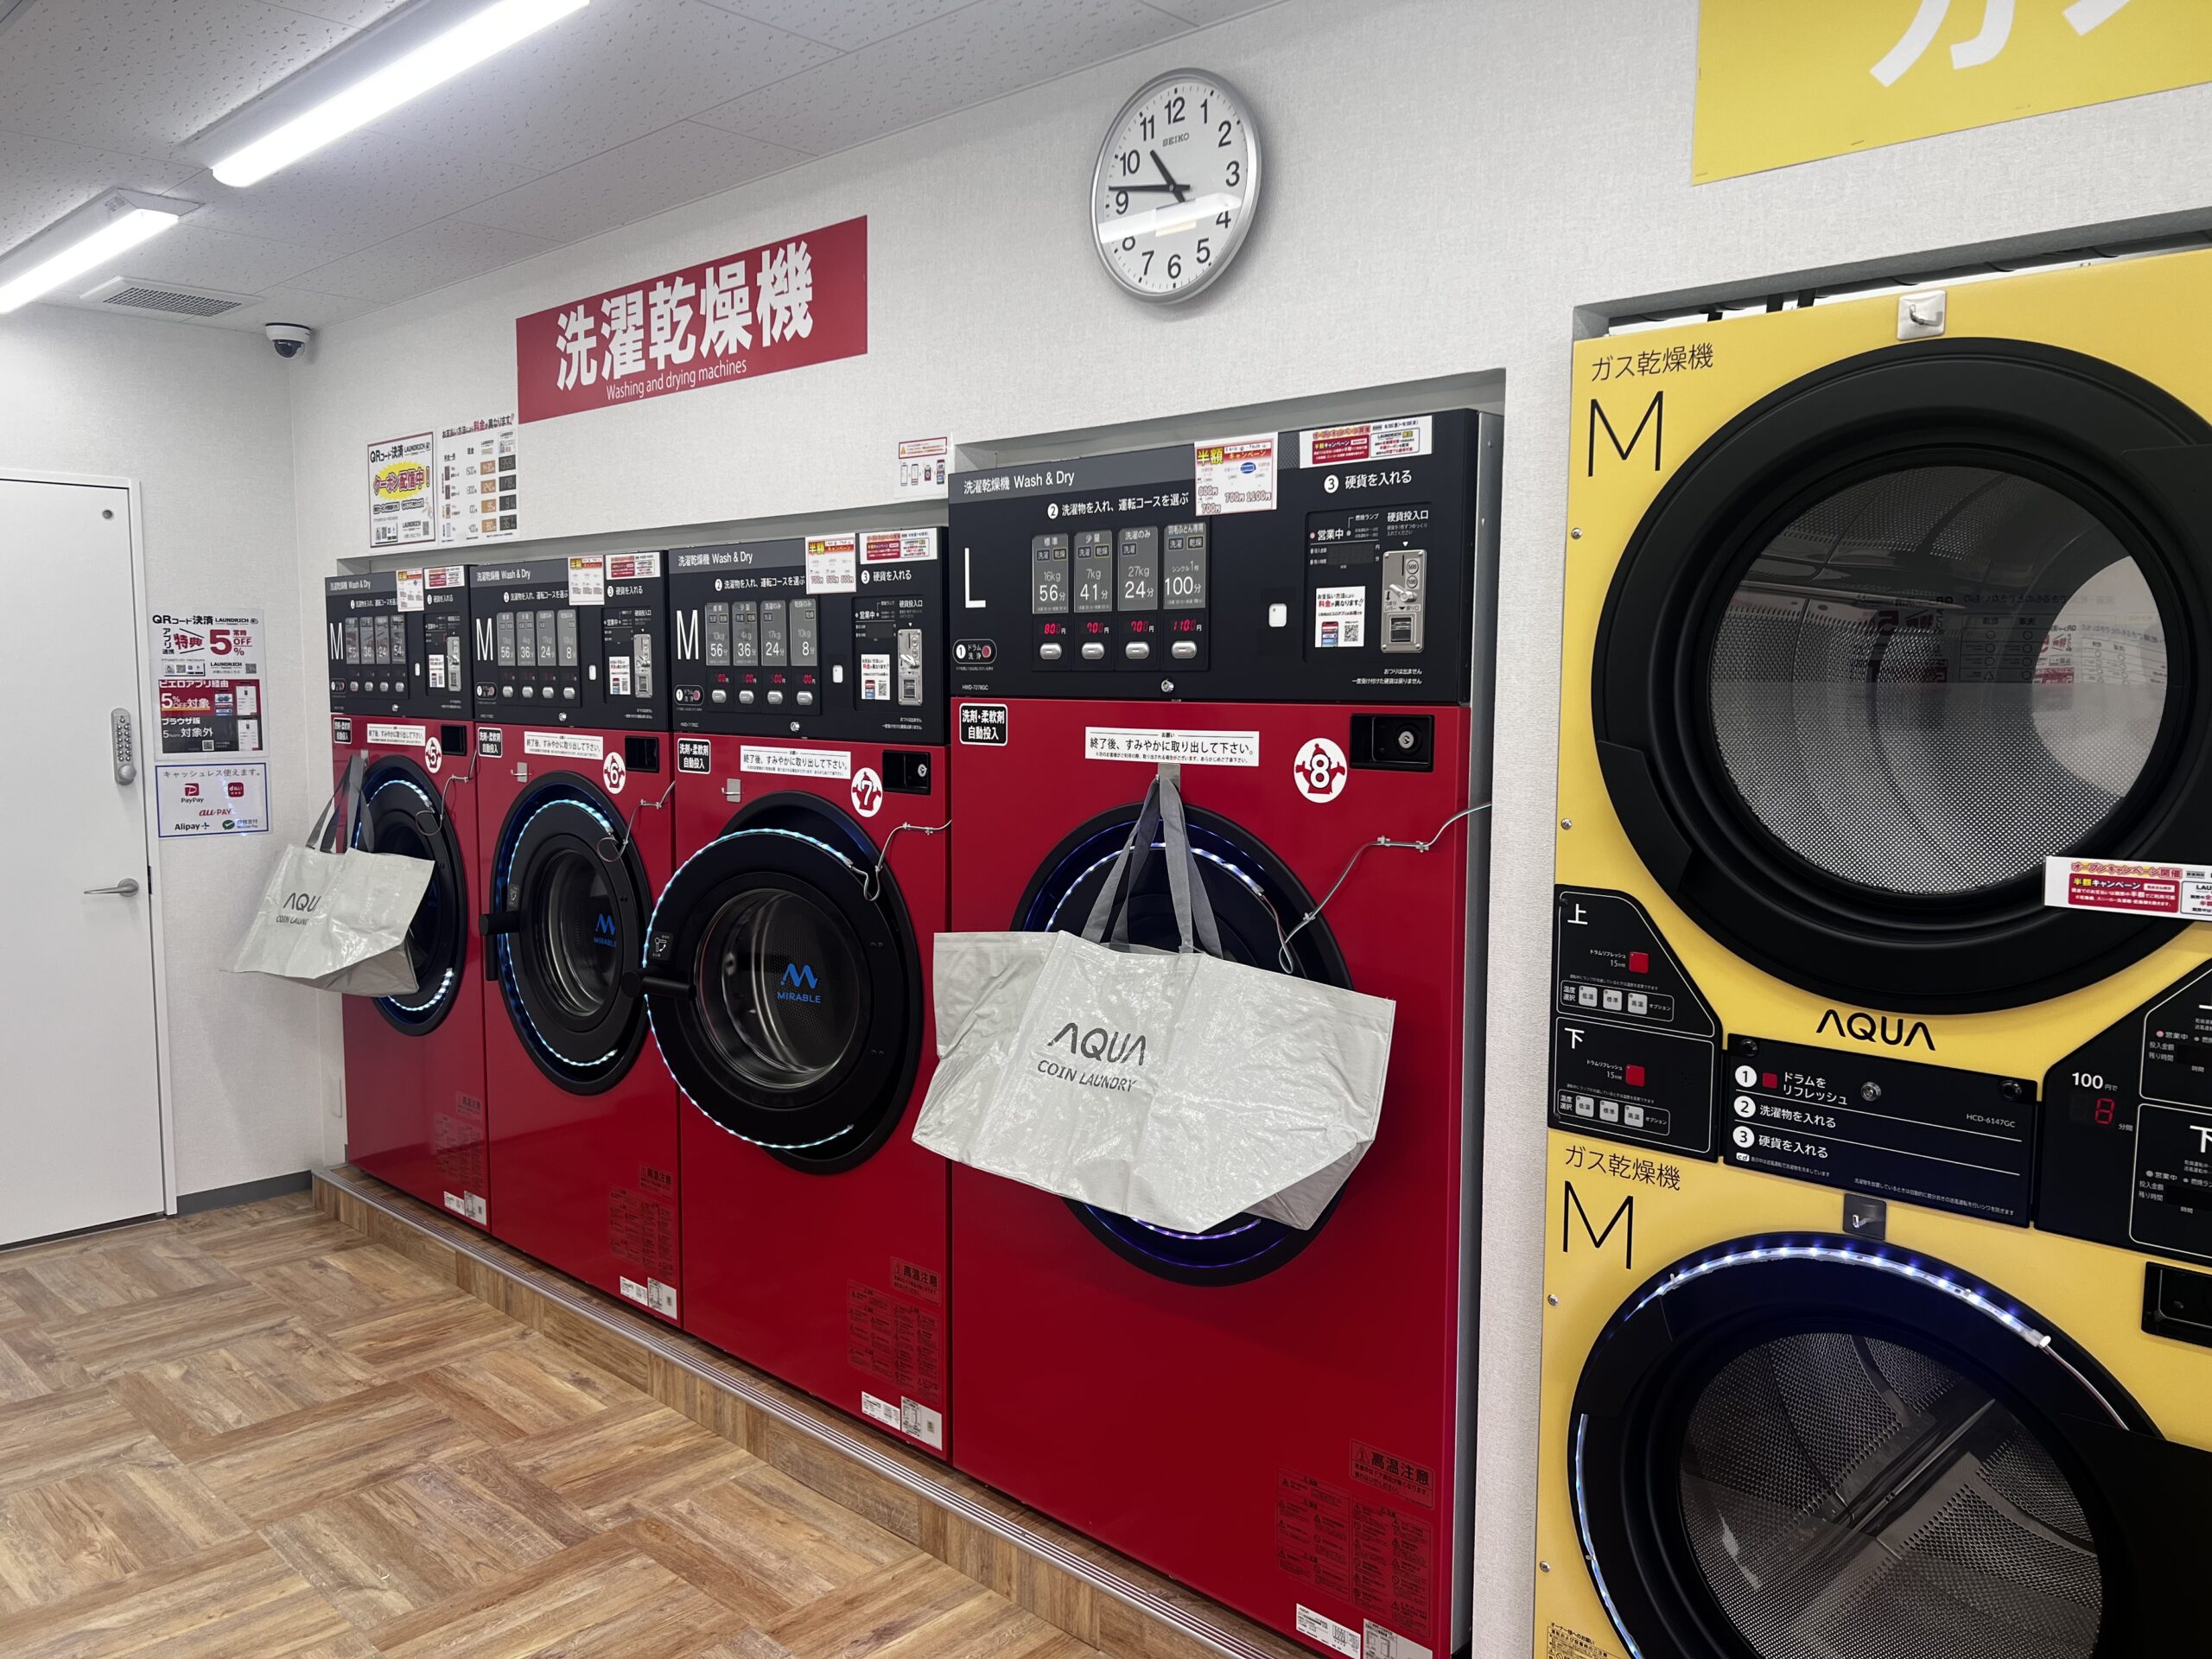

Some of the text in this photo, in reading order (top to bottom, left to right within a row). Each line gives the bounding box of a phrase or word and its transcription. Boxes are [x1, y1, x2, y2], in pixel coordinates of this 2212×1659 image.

[1165, 97, 1185, 124] 12
[1200, 99, 1208, 124] 1
[1140, 115, 1155, 142] 11
[1218, 120, 1232, 148] 2
[1162, 133, 1190, 147] SEIKO
[1120, 149, 1140, 176] 10
[1225, 161, 1240, 187] 3
[1116, 189, 1128, 214] 9
[1197, 238, 1211, 264] 5
[1141, 251, 1154, 276] 7
[1167, 254, 1181, 279] 6
[556, 239, 813, 391] 洗濯乾燥機
[1592, 342, 1714, 382] ガス乾燥機
[606, 359, 747, 400] Washing and drying machines
[1587, 391, 1664, 477] M
[1197, 448, 1224, 466] 半額
[1229, 449, 1267, 460] キャンペーン
[963, 471, 1075, 494] 洗濯乾燥機 Wash & Dry
[1344, 469, 1413, 490] 硬貨を入れる
[1061, 492, 1189, 516] 洗濯物を入れ、運転コースを選ぶ
[1387, 510, 1429, 523] 硬貨投入口
[1124, 530, 1151, 541] 洗濯のみ
[1317, 529, 1344, 541] 営業中
[678, 551, 753, 567] 洗濯乾燥機 Wash & Dry
[501, 569, 517, 579] Wash
[522, 569, 531, 580] Dry
[873, 569, 912, 582] 硬貨を入れる
[964, 547, 987, 608] L
[1043, 571, 1061, 582] 16kg
[1086, 569, 1102, 580] 7kg
[1128, 566, 1150, 577] 27kg
[1039, 584, 1066, 601] 56分
[1080, 583, 1109, 601] 41分
[1124, 581, 1154, 599] 24分
[1165, 576, 1202, 595] 100分
[152, 614, 213, 626] QRコード決済
[173, 633, 203, 650] 特典
[209, 629, 232, 656] 5
[329, 622, 344, 660] M
[476, 618, 493, 661] M
[676, 610, 699, 660] M
[233, 647, 245, 656] %
[962, 709, 1005, 725] 洗剤・柔軟剤
[968, 725, 999, 741] 自動投入
[429, 746, 437, 765] 5
[1090, 737, 1254, 755] 終了後、すみやかに取り出して下さい。
[743, 753, 848, 772] 終了後、すみやかに取り出して下さい。
[1310, 753, 1331, 789] 8
[163, 768, 261, 779] キャッシュレス使えます。
[610, 762, 619, 785] 6
[861, 780, 873, 806] 7
[2071, 862, 2183, 880] オープンキャンペーン開催
[2074, 877, 2141, 890] 半額キャンペーン
[276, 914, 289, 924] COIN
[1567, 903, 1588, 925] 上
[594, 936, 618, 948] MIRABLE
[778, 991, 821, 1004] MIRABLE
[1564, 1027, 1585, 1050] 下
[1816, 1008, 1936, 1052] AQUA
[1047, 1022, 1147, 1066] AQUA
[2149, 1041, 2175, 1051] 投入金額
[2148, 1052, 2174, 1062] 残り時間
[1037, 1059, 1137, 1092] COIN LAUNDRY
[1784, 1071, 1827, 1089] ドラムを
[1783, 1084, 1848, 1106] リフレッシュ
[1759, 1103, 1836, 1128] 洗濯物を入れる
[1966, 1113, 2016, 1128] HCD-6147GC
[1758, 1134, 1828, 1159] 硬貨を入れる
[1565, 1145, 1681, 1192] ガス乾燥機
[1562, 1180, 1633, 1270] M
[1371, 1452, 1428, 1486] 高温注意
